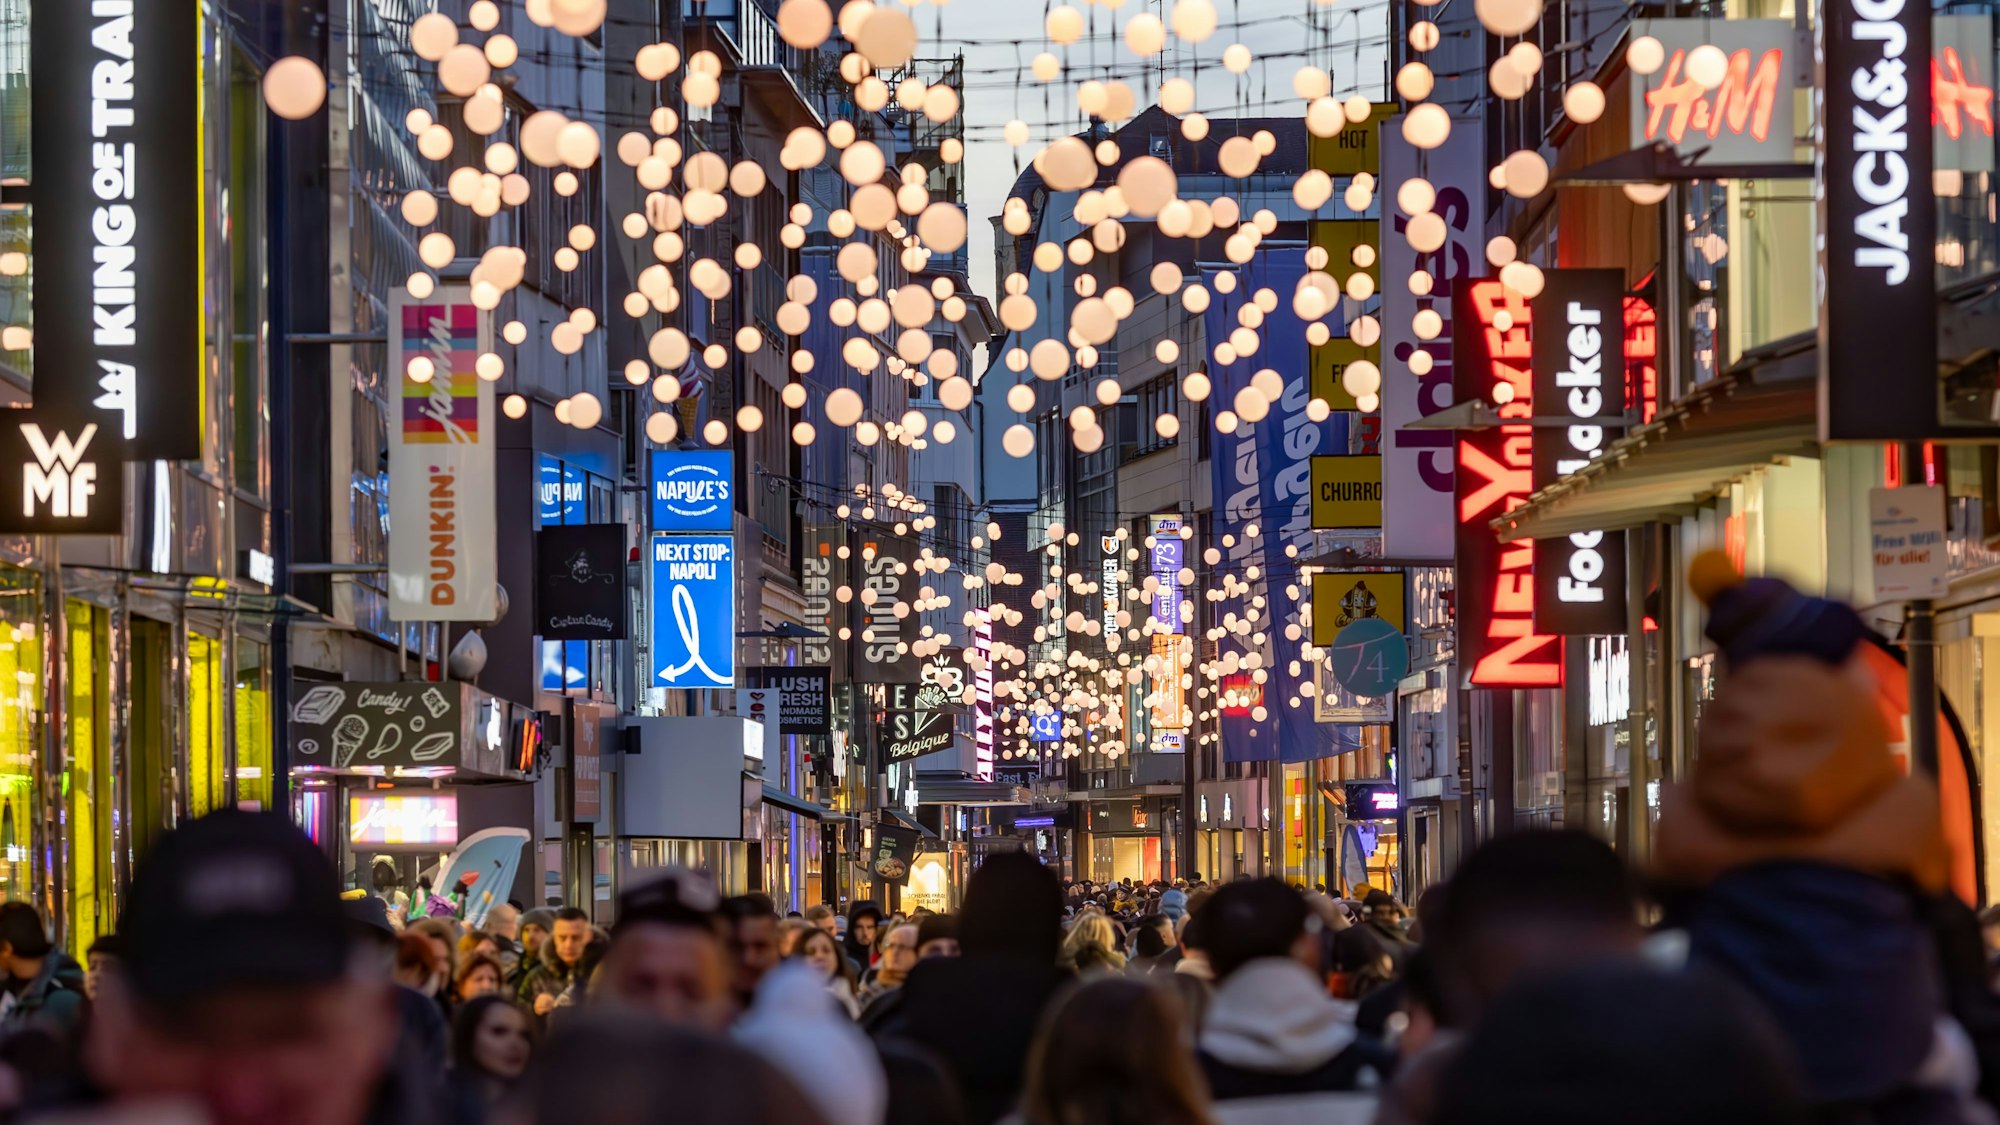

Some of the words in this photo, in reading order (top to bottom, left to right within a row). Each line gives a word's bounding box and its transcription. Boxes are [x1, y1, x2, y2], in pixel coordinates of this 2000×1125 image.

[1645, 48, 1782, 144] H&M
[1338, 130, 1369, 150] HOT
[92, 142, 135, 199] OF
[92, 204, 137, 346] KING
[417, 304, 472, 444] jamin
[656, 480, 729, 504] NAPULE'S
[428, 464, 456, 606] DUNKIN'
[655, 543, 692, 562] NEXT
[693, 543, 731, 562] STOP:
[1155, 542, 1176, 566] 73
[669, 563, 717, 581] NAPOLI
[770, 676, 824, 692] LUSH
[356, 688, 413, 715] Candy!
[779, 692, 824, 706] RESH
[779, 707, 823, 715] ANDMADE
[779, 716, 823, 725] OSMETICS
[889, 732, 950, 758] Belgique
